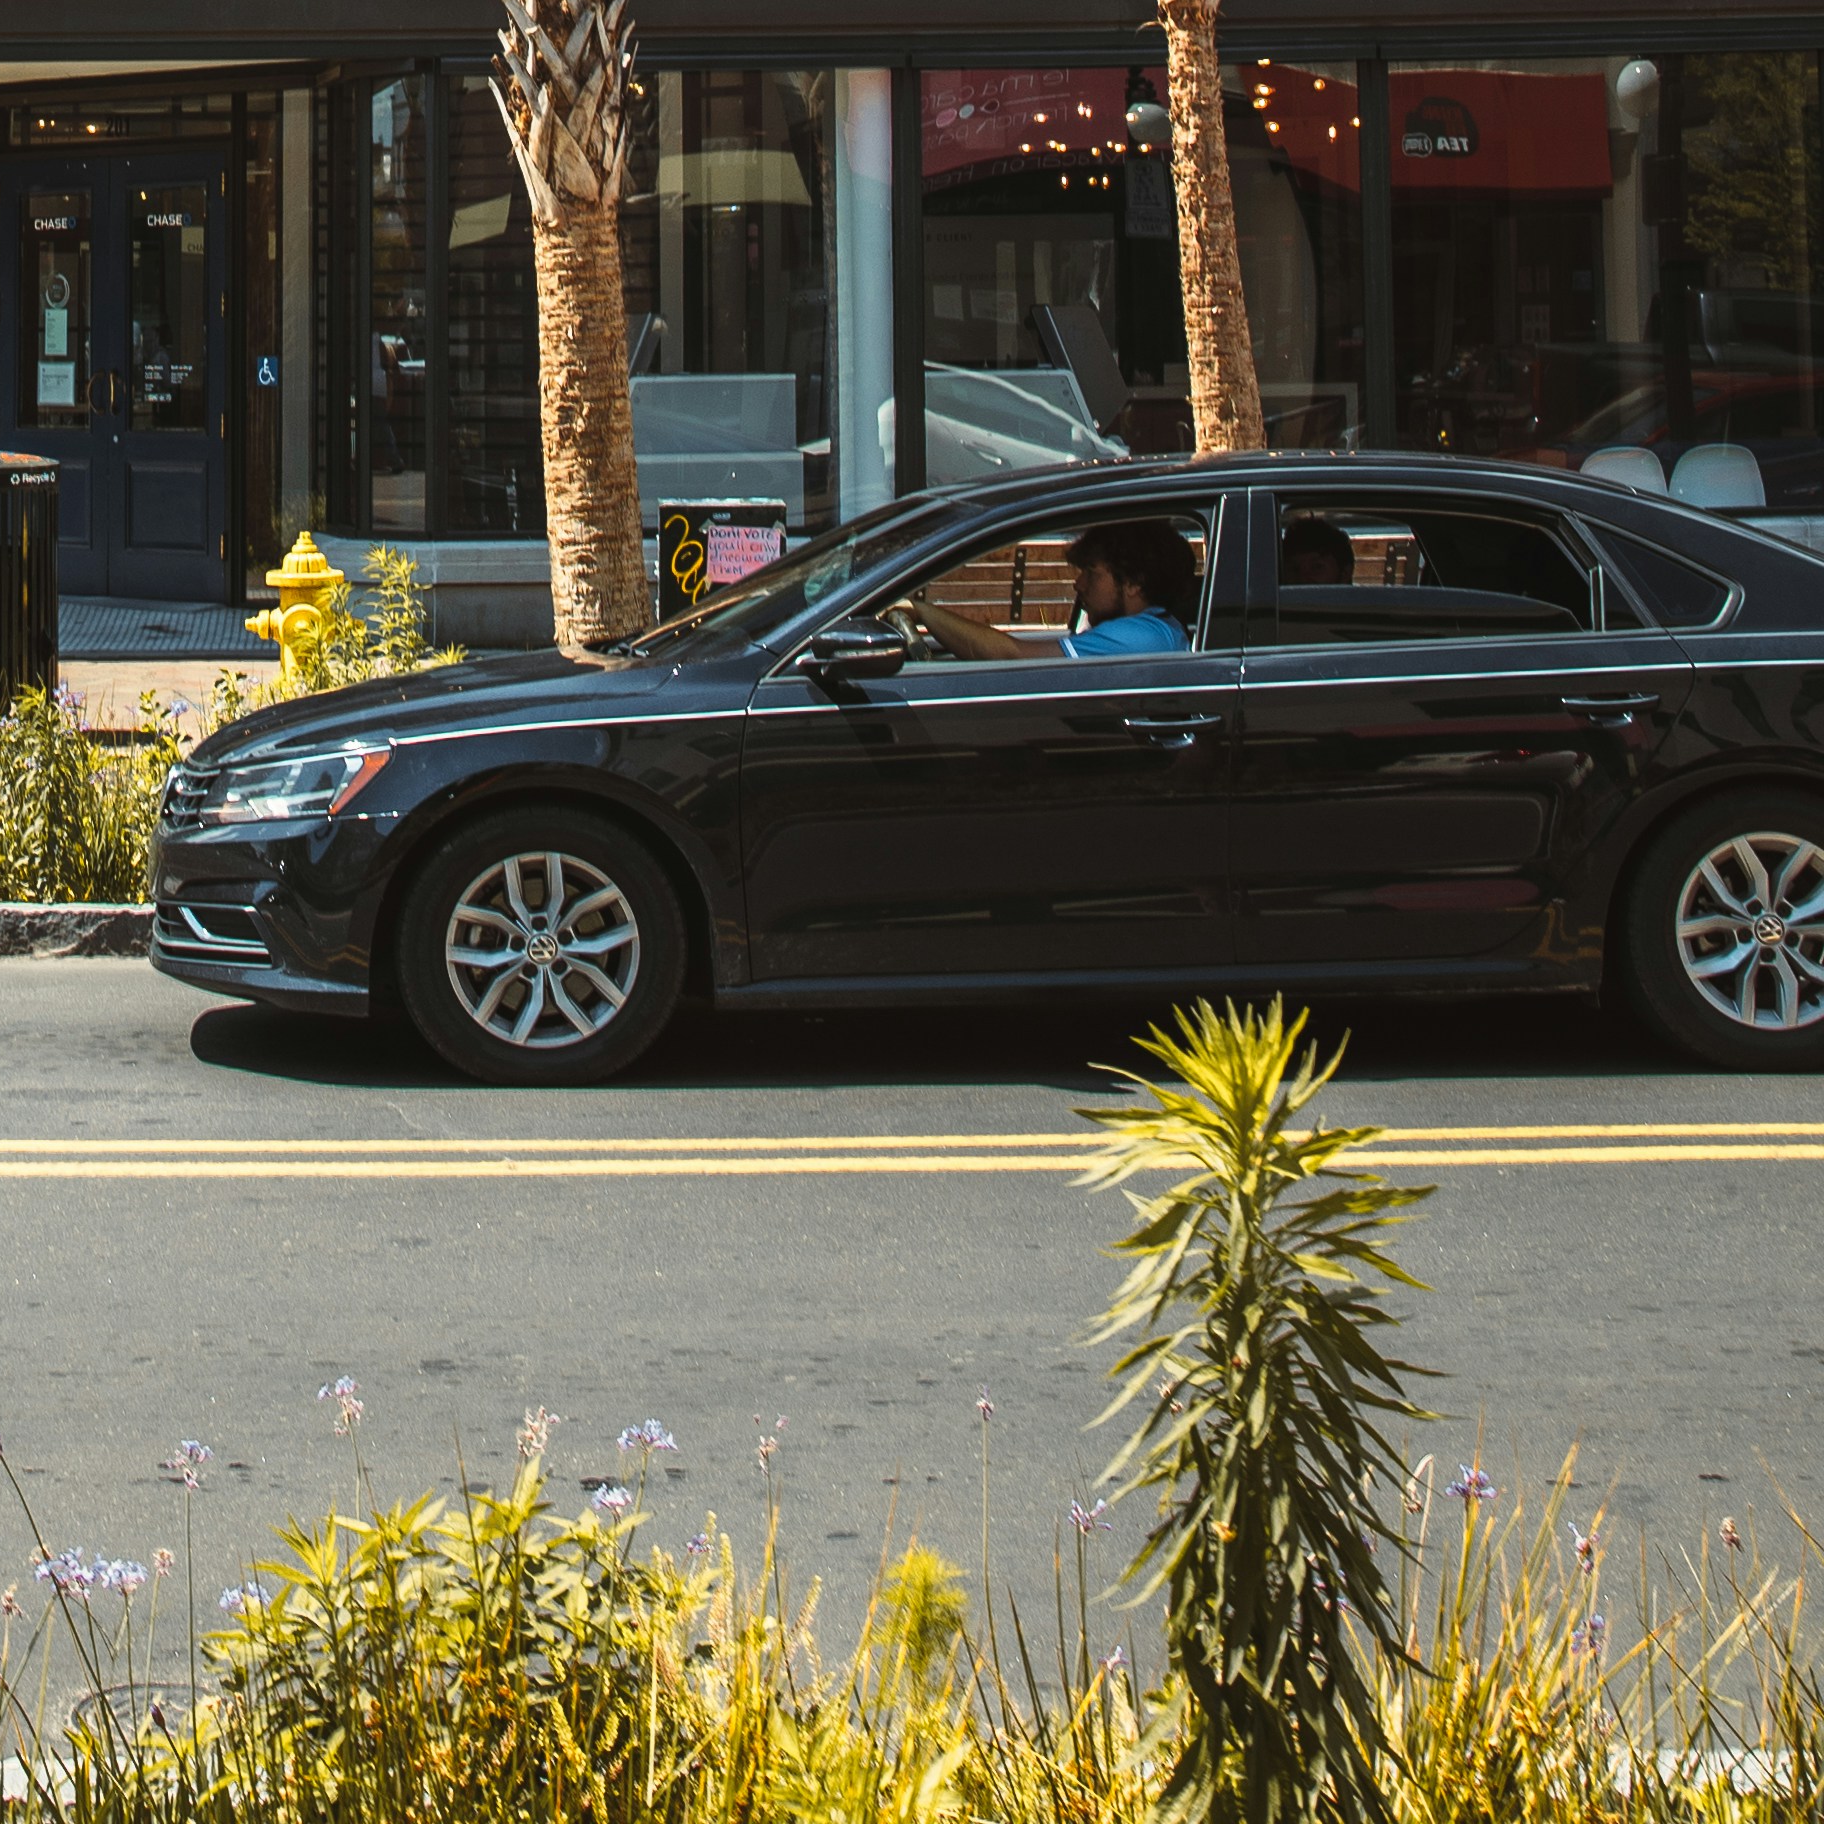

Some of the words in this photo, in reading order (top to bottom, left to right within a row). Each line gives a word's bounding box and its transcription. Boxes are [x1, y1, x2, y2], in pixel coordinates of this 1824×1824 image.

[34, 217, 68, 231] CHASE
[147, 213, 183, 227] CHASE
[22, 472, 50, 485] Recycle
